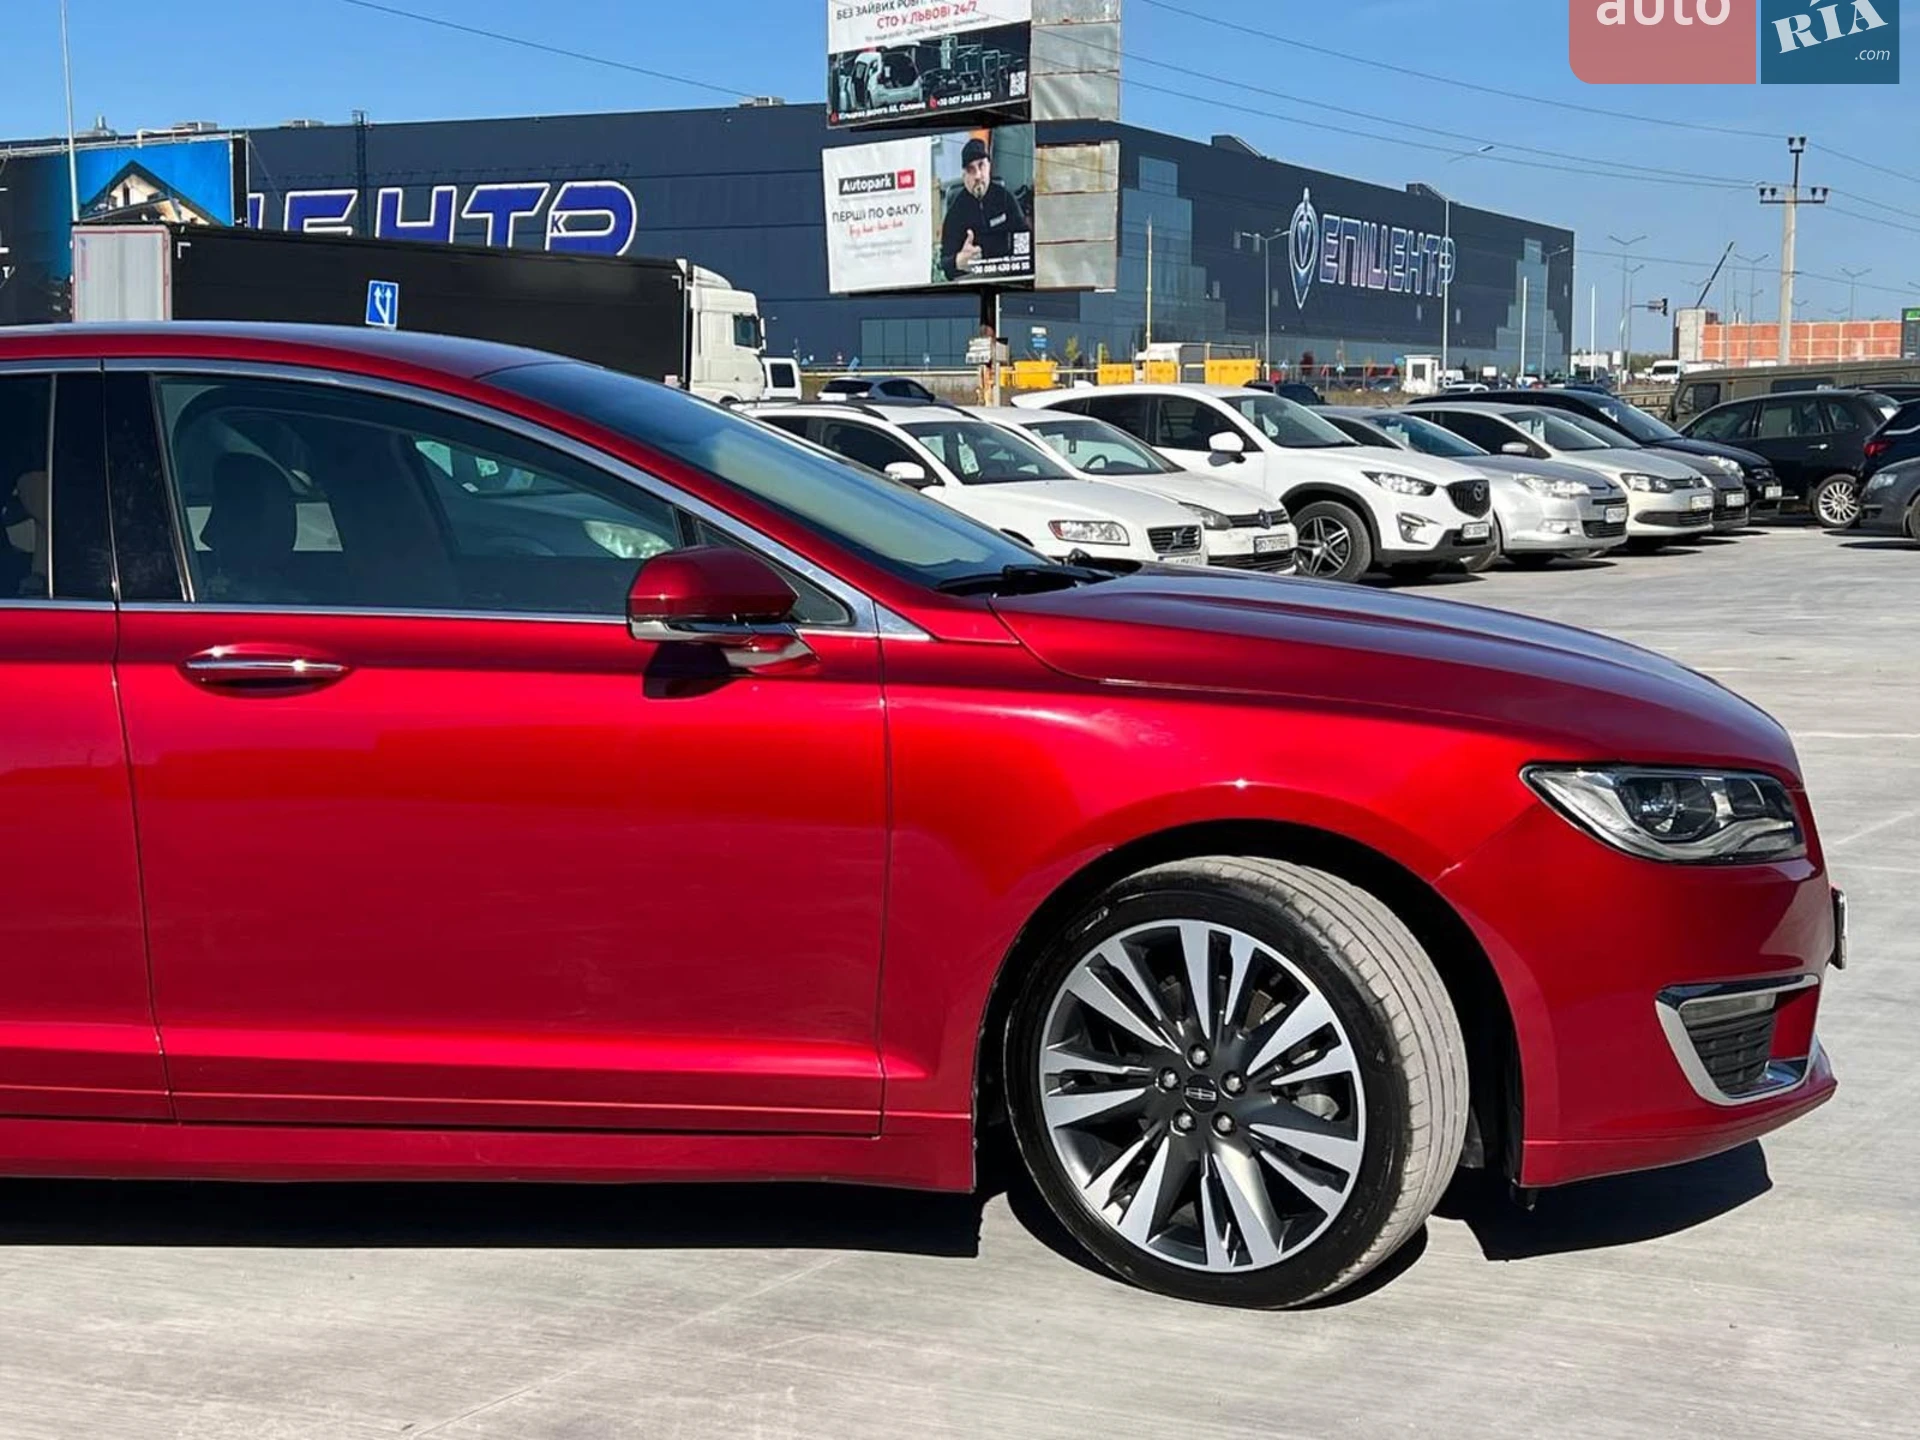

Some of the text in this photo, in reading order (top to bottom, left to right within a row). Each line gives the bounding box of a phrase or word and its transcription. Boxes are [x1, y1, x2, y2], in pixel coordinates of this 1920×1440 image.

[836, 8, 853, 20] БЕЗ
[856, 1, 895, 16] ЗАЙВИХ
[877, 15, 899, 29] СТО
[911, 7, 951, 24] ЛЬВОВІ
[954, 1, 977, 15] 24/7
[842, 174, 892, 192] Autopark
[832, 209, 866, 223] ПЕРШІ
[868, 206, 884, 219] ПО
[1319, 213, 1457, 298] ЕПІЦЕНТР
